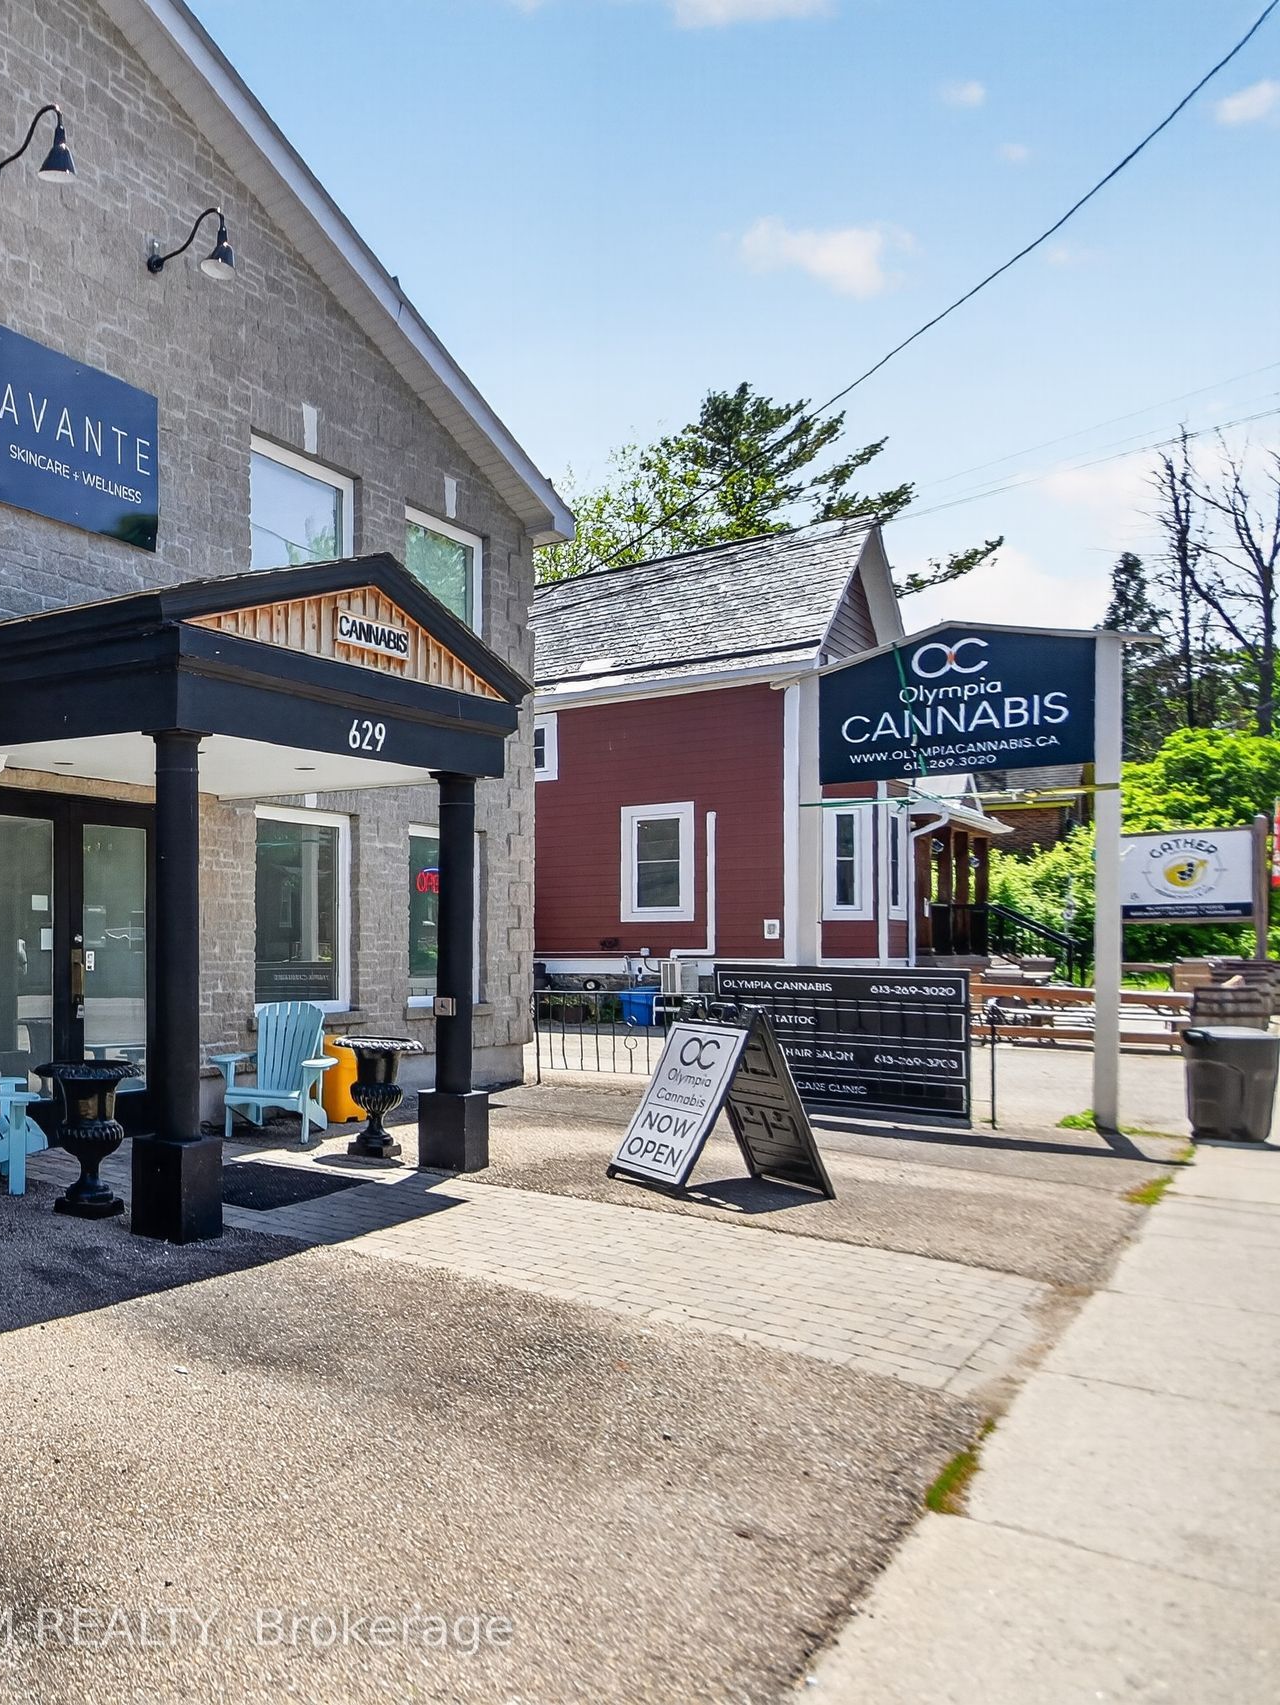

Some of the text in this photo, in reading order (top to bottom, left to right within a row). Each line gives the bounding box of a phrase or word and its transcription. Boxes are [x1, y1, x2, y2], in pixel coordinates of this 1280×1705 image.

[0, 383, 151, 476] AVANTE
[9, 444, 70, 479] SKINCARE
[82, 470, 142, 504] WELLNESS
[339, 615, 408, 653] CANNABIS
[899, 676, 1002, 705] Olympia
[841, 691, 1070, 743] CANNABIS
[349, 719, 386, 752] 629
[1150, 838, 1218, 859] GATHER
[723, 979, 956, 996] OLYMPIA CANNABIS 613-269-3020
[785, 1048, 813, 1058] HAIR
[815, 1049, 854, 1061] SALON
[667, 1067, 712, 1088] Olympia
[656, 1087, 707, 1109] Cannabis
[641, 1110, 696, 1139] NOW
[627, 1136, 684, 1168] OPEN
